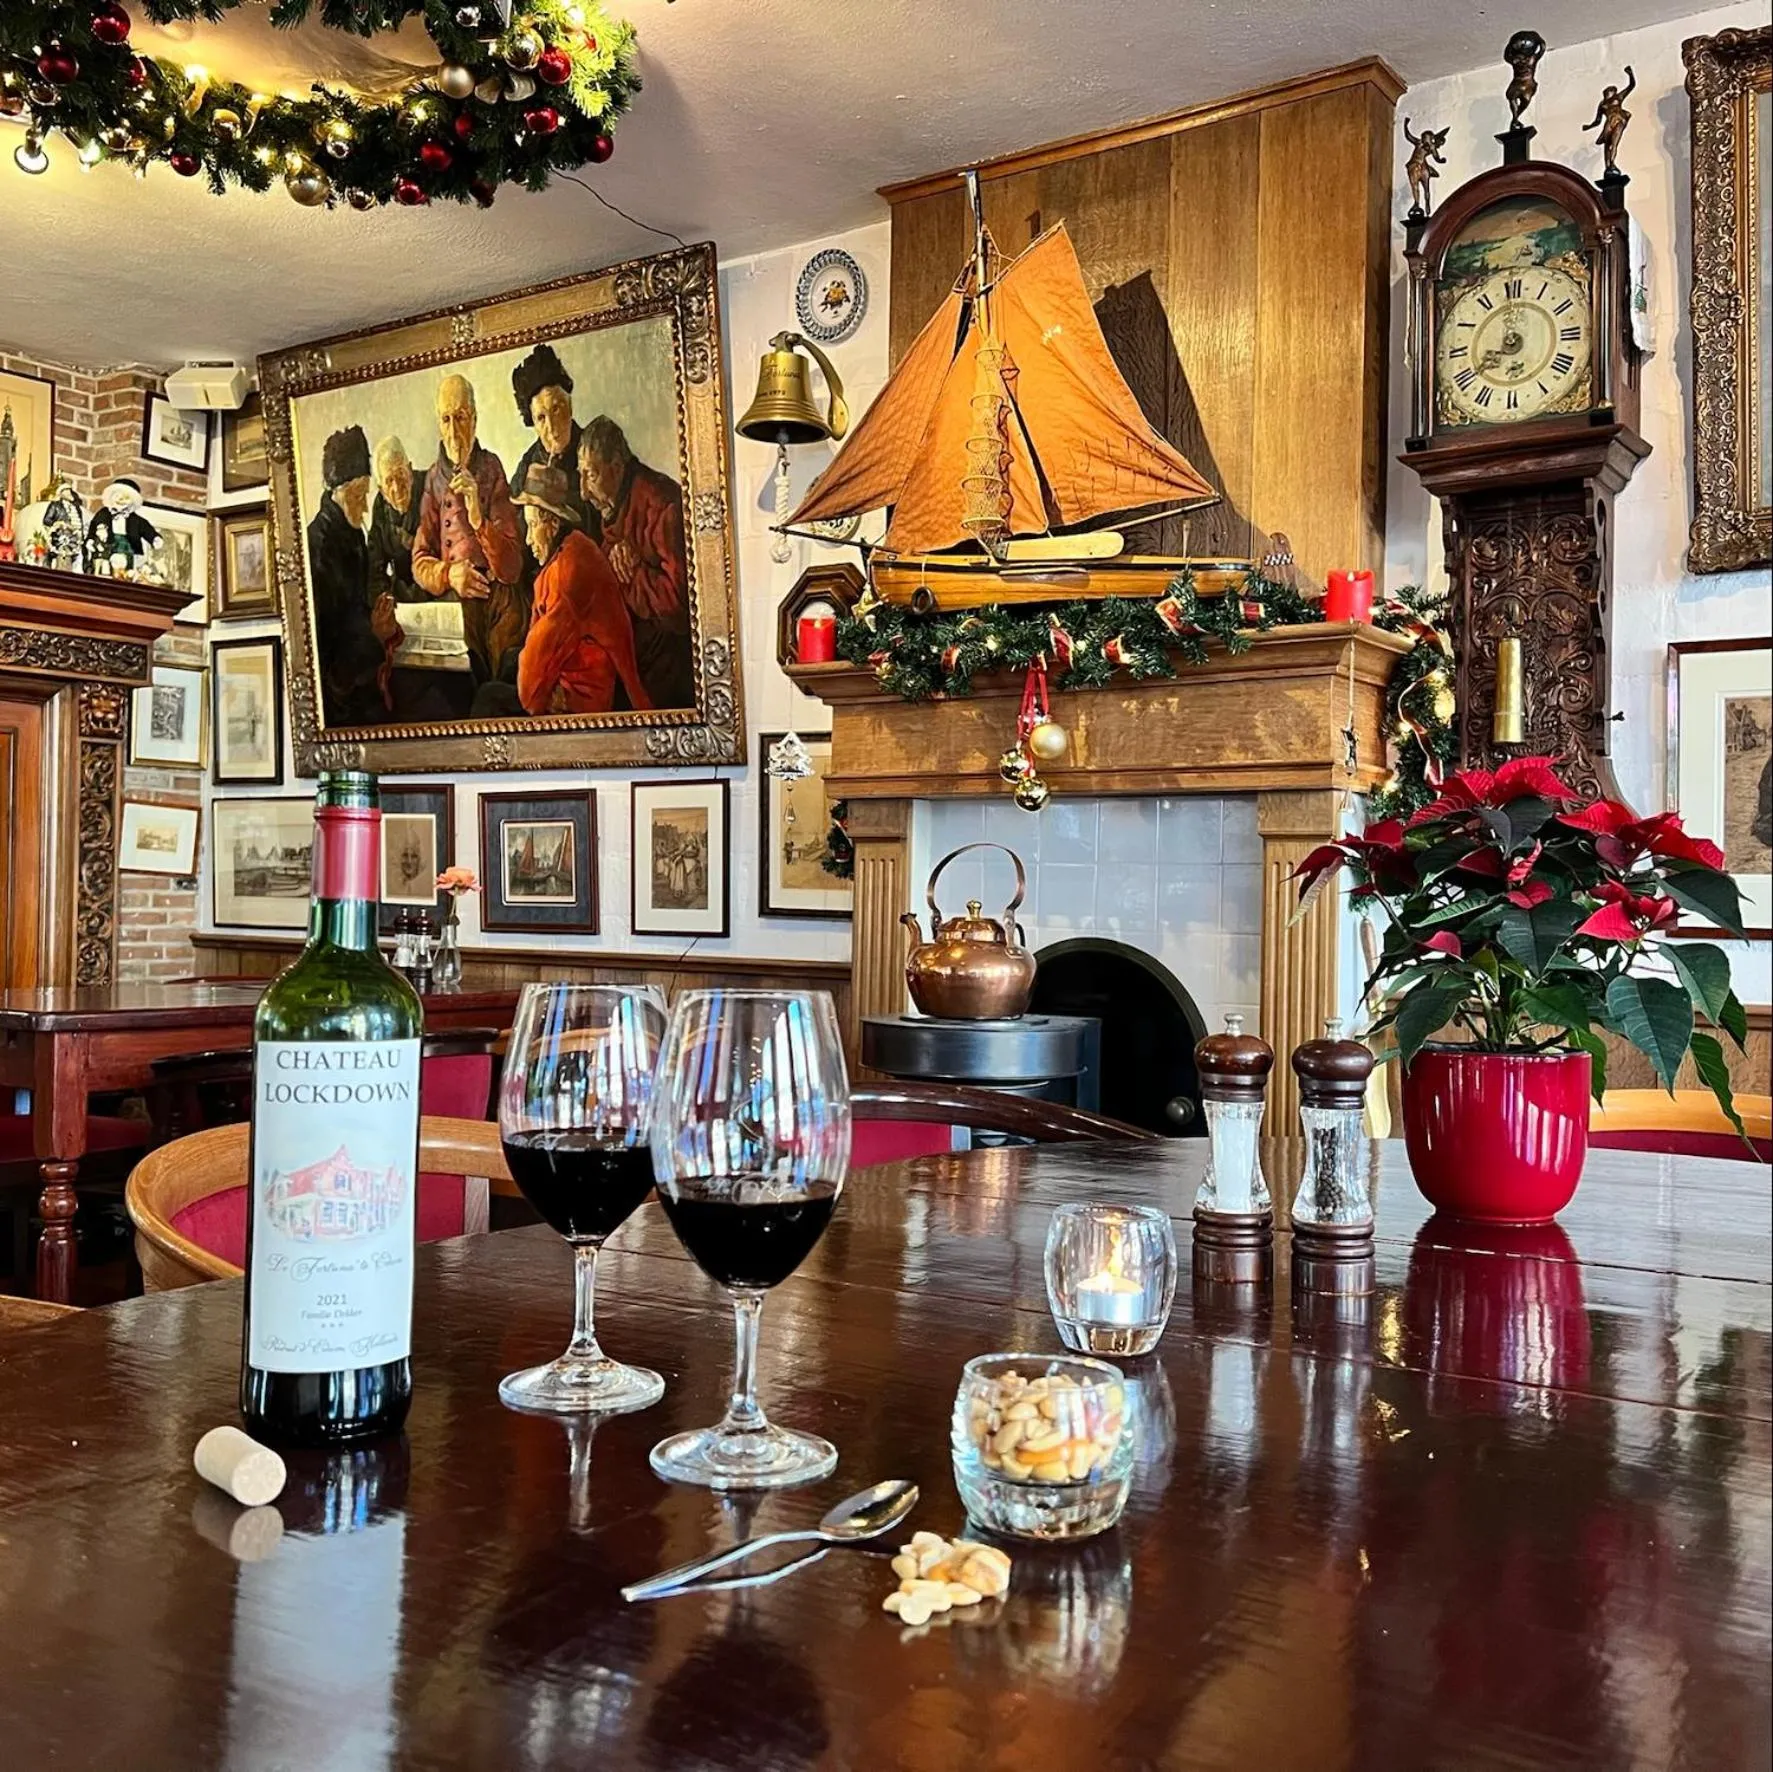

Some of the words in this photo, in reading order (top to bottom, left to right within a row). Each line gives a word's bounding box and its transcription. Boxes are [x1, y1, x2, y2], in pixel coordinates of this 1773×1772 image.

[276, 1048, 402, 1070] CHATEAU
[265, 1081, 410, 1104] LOCKDOWN
[316, 1294, 348, 1306] 2021
